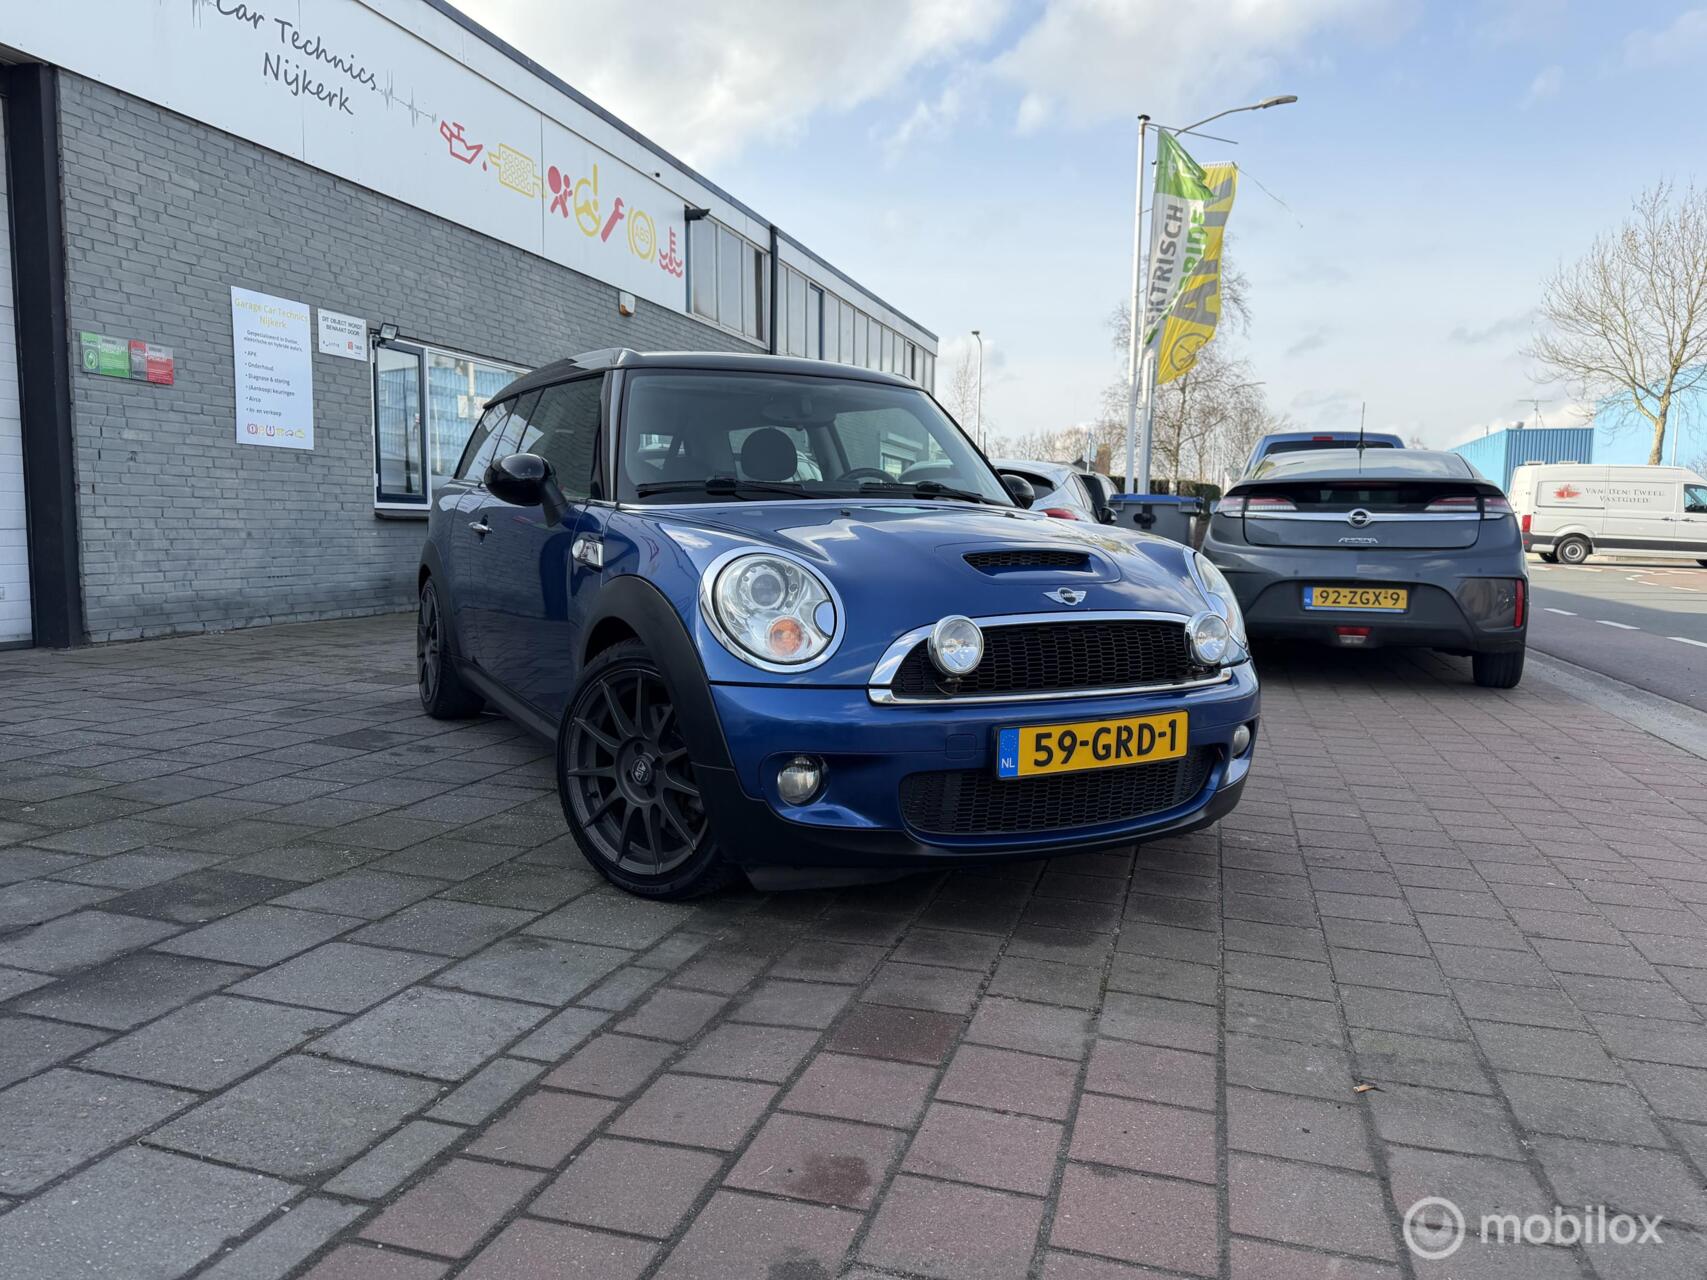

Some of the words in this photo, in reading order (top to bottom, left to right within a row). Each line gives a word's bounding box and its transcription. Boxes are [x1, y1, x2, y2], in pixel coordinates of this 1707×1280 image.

[216, 0, 264, 29] Car
[274, 18, 377, 91] Technics
[263, 52, 354, 115] Nijkerk
[635, 225, 649, 244] ABS
[234, 298, 261, 313] Garage
[264, 304, 277, 314] Car
[260, 315, 288, 329] Nijkerk
[1319, 590, 1401, 606] 92-ZGX-9
[1033, 719, 1178, 767] 59-GRD-1
[1001, 757, 1015, 769] NL
